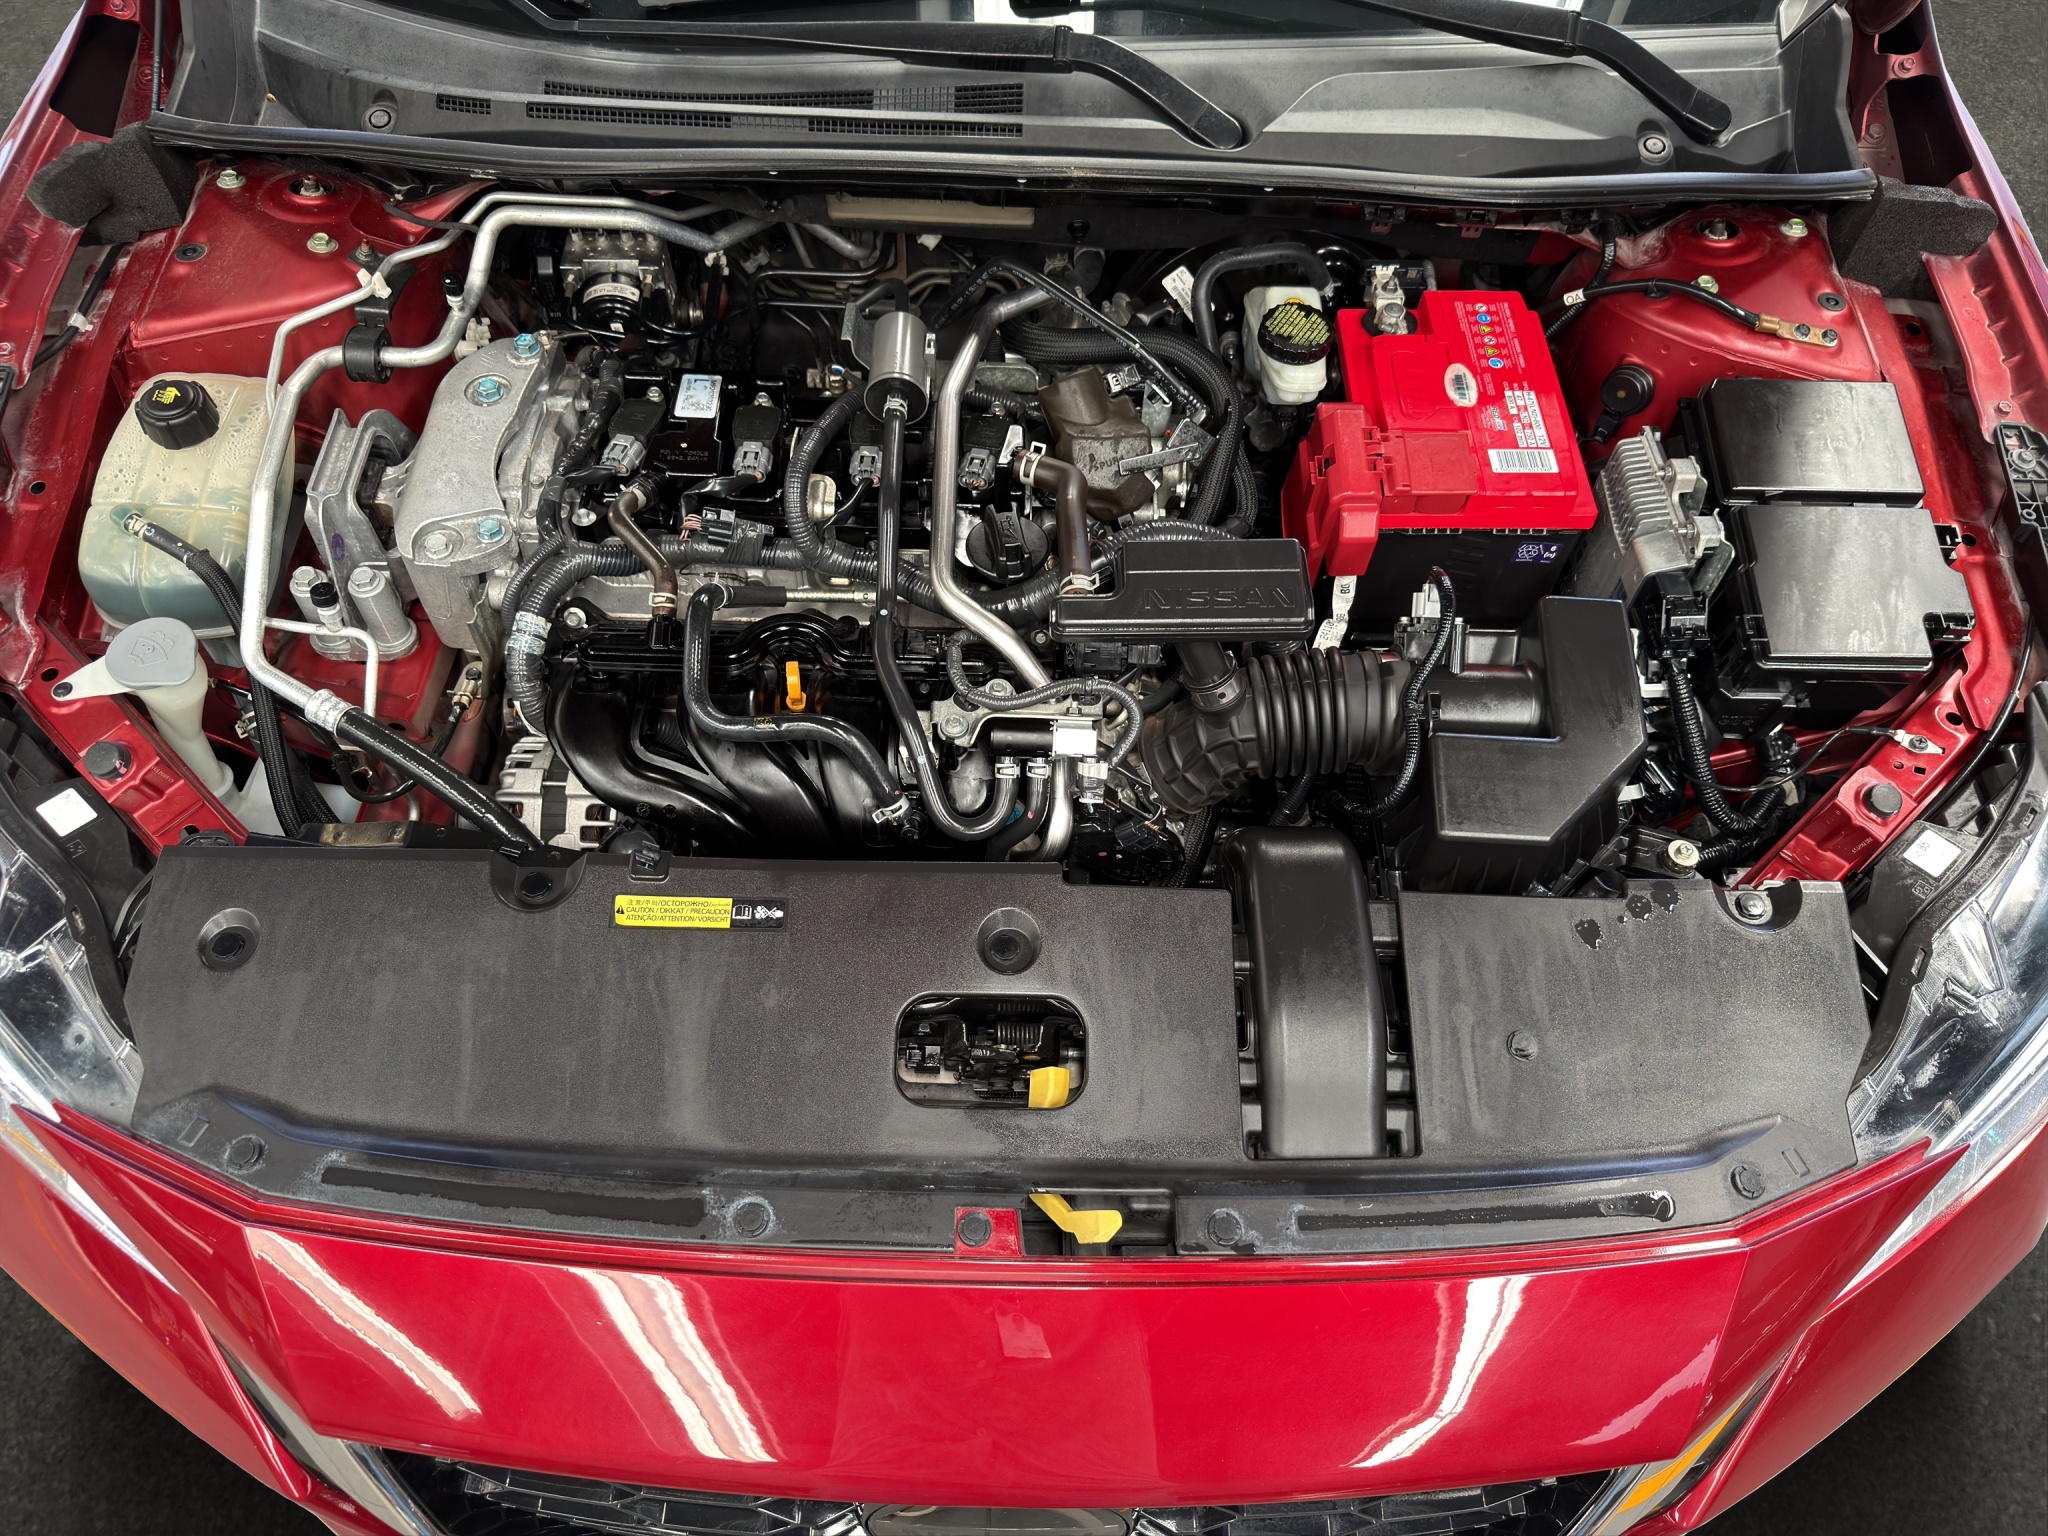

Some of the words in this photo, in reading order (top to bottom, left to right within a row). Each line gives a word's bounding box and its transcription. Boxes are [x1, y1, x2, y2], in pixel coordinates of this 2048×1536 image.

[1521, 411, 1529, 423] LN2
[1537, 434, 1547, 446] 12V
[1144, 588, 1295, 609] NISSAN
